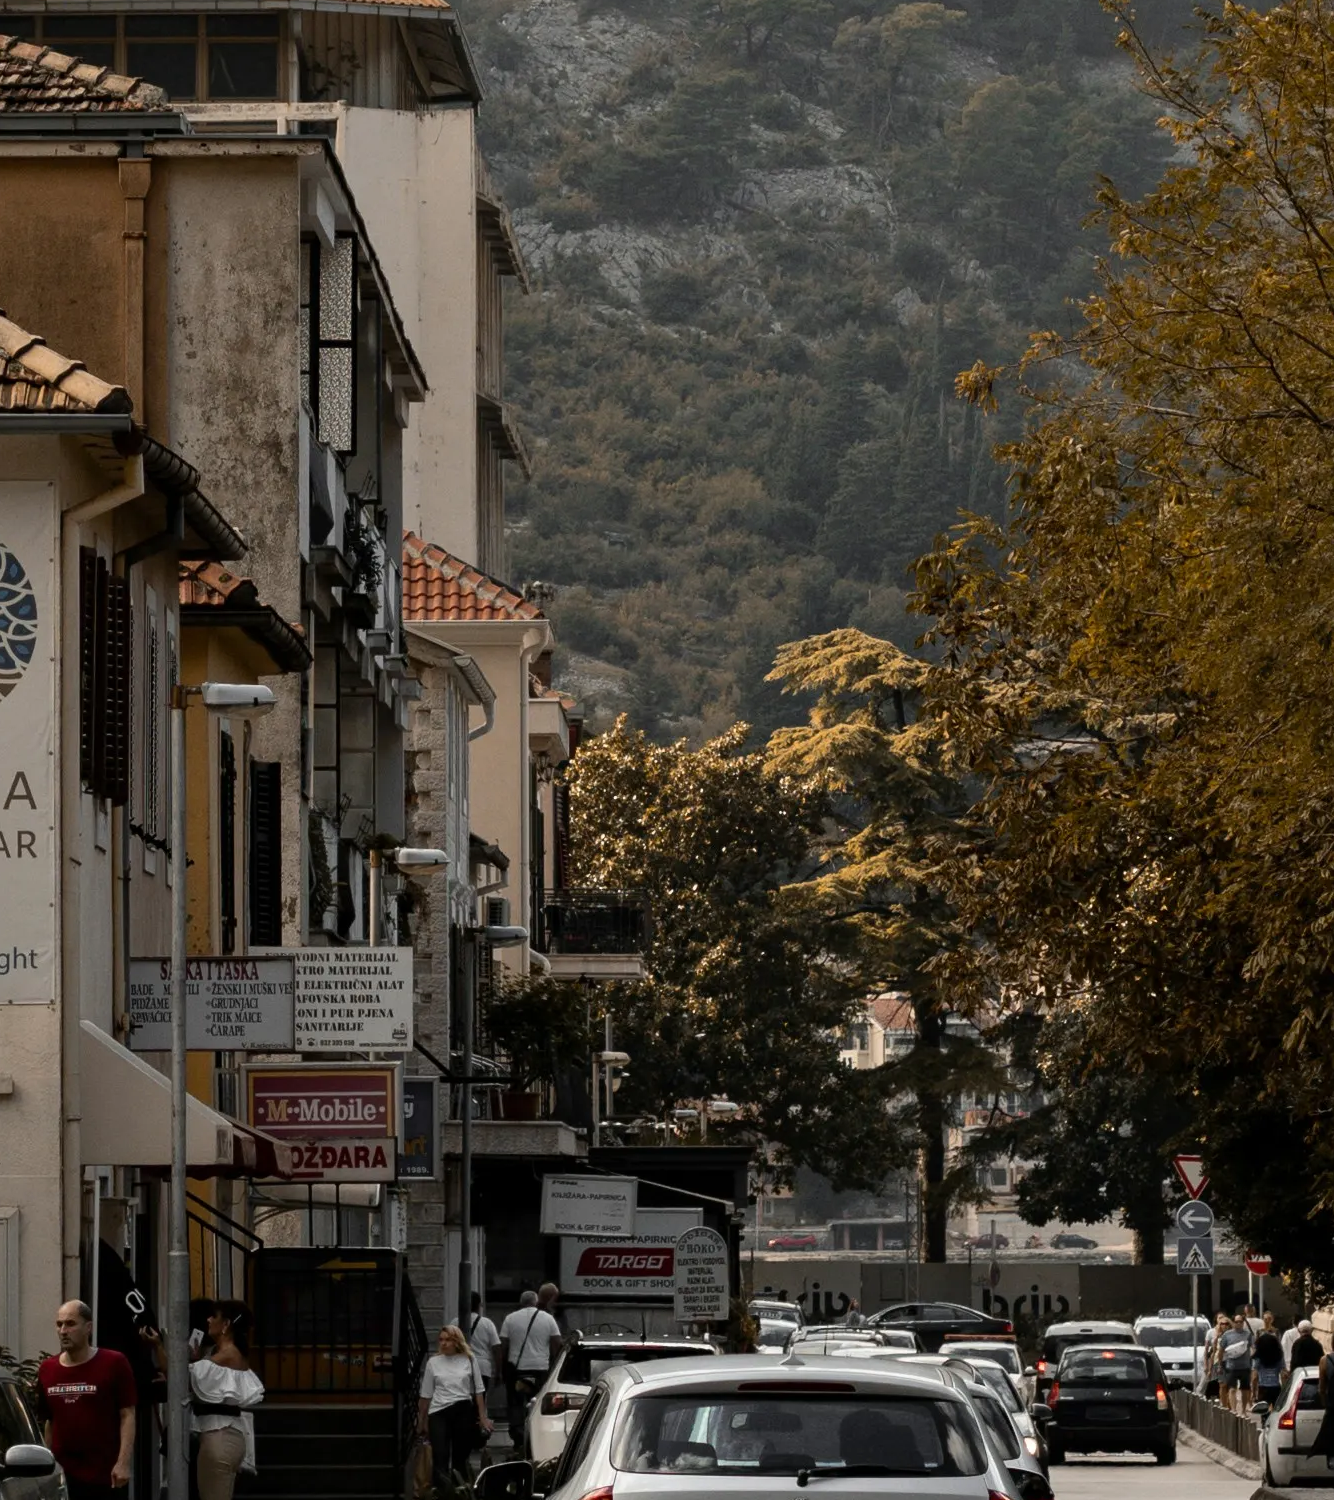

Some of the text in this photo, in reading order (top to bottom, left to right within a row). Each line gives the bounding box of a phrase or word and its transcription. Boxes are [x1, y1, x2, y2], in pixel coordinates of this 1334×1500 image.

[334, 952, 398, 962] MATERIJAL
[328, 965, 393, 975] MATERIJAL
[131, 984, 155, 995] BADE
[211, 982, 241, 995] ŽENSKI
[249, 982, 276, 995] MUŠKI
[376, 980, 405, 990] ALAT
[131, 996, 170, 1010] PIDŽAME
[350, 994, 381, 1004] ROBA
[211, 1012, 233, 1023] TRIK
[330, 1008, 354, 1018] PUR
[358, 1008, 395, 1018] PJENA
[210, 1025, 246, 1036] ČARAPE
[296, 1022, 365, 1032] SANITARIJE
[601, 1224, 623, 1232] SHOP
[594, 1254, 671, 1270] TARGET
[583, 1279, 613, 1288] BOOK
[615, 1279, 623, 1288] &
[625, 1279, 648, 1288] GIFT
